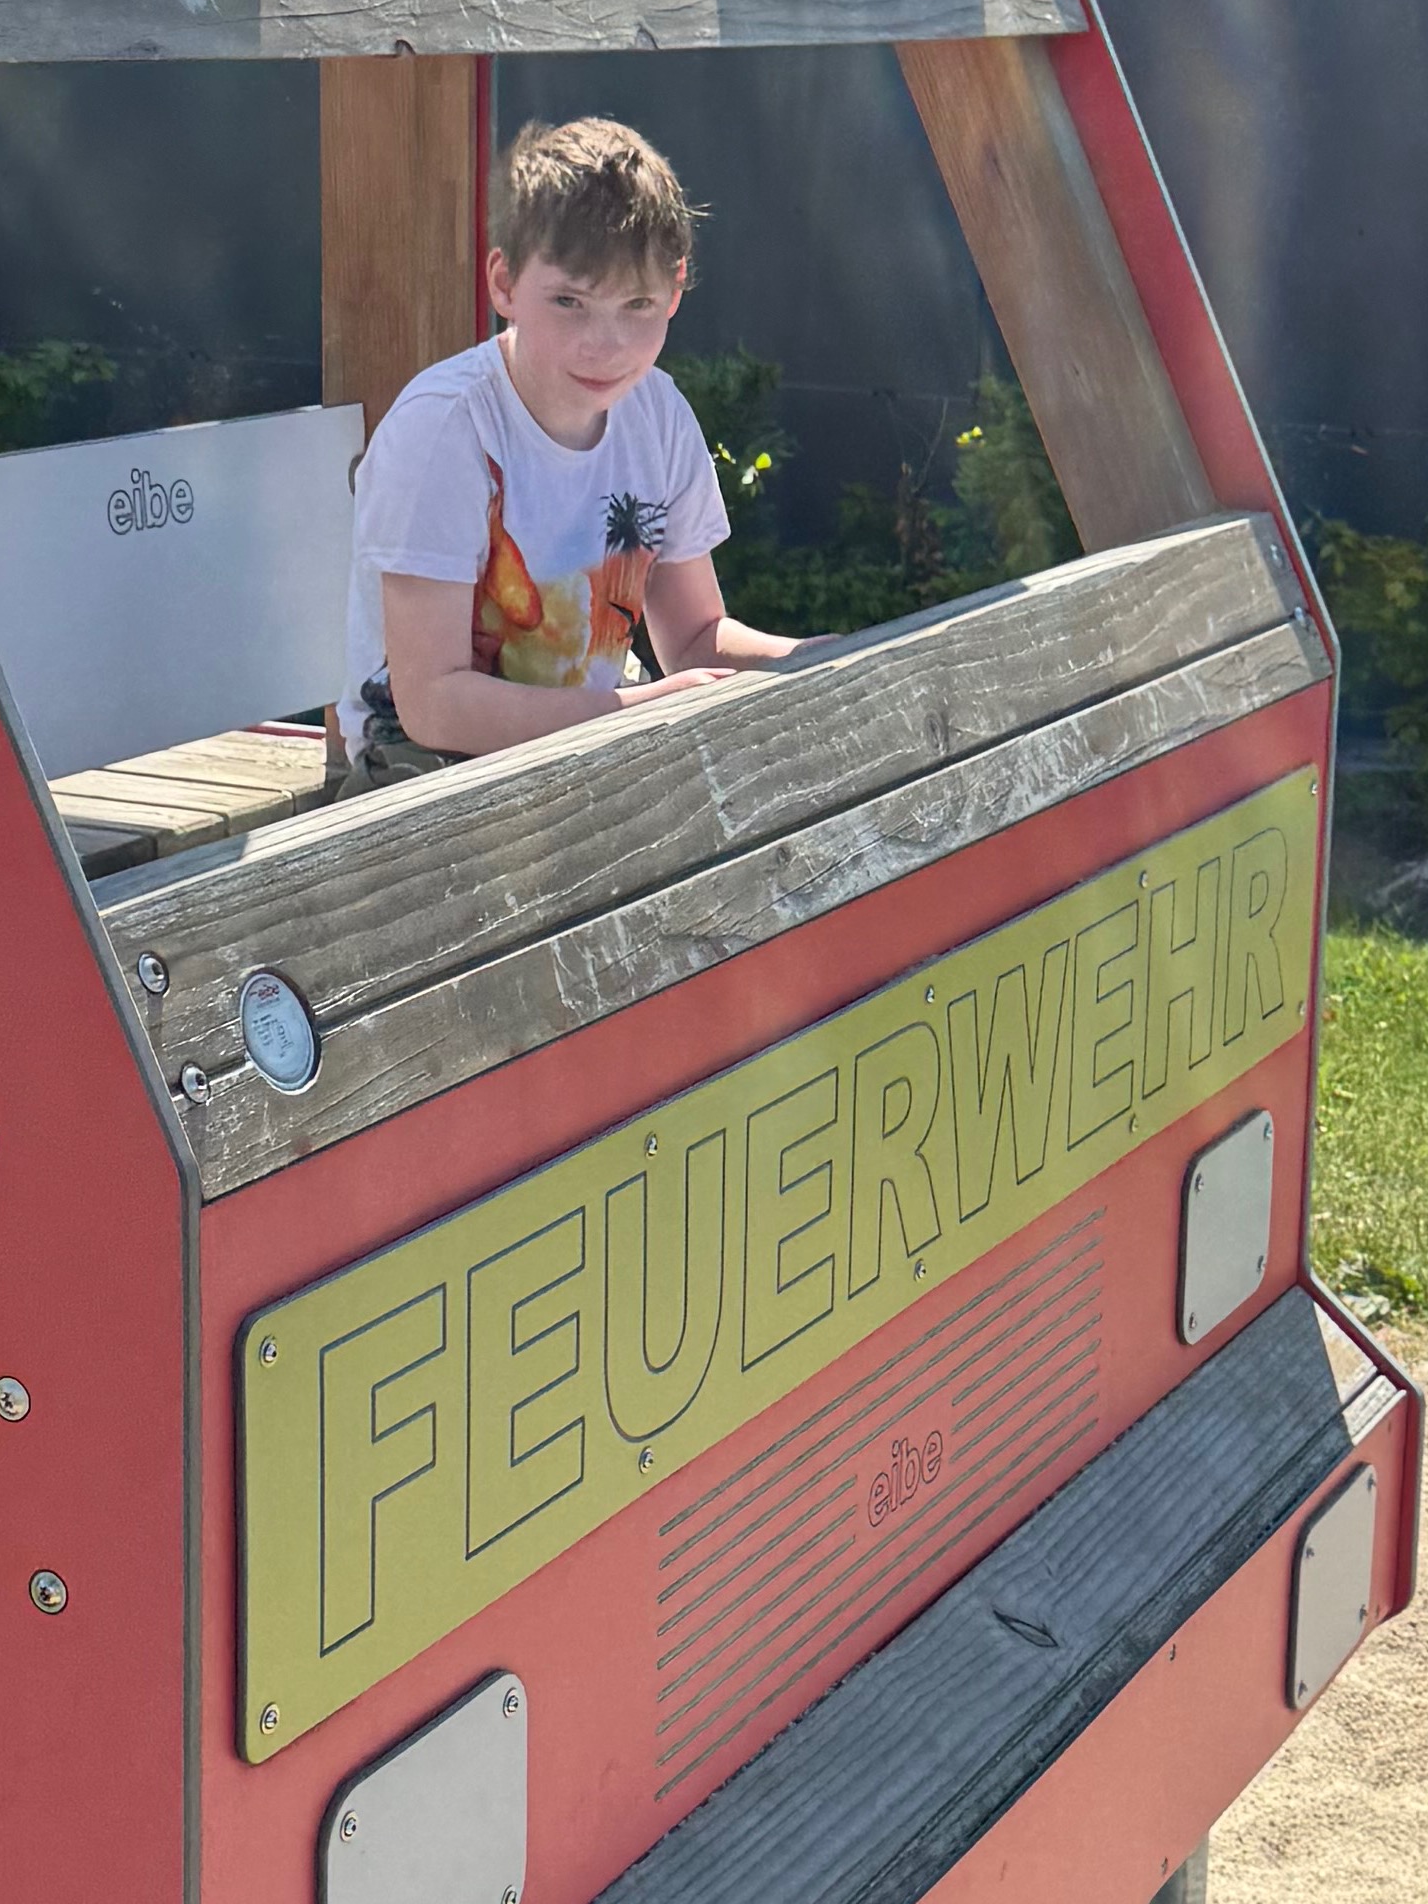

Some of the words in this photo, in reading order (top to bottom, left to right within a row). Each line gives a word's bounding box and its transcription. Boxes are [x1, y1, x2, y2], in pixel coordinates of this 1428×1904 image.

[107, 468, 194, 535] eibe
[320, 827, 1288, 1658] FEUERWEHR
[868, 1430, 943, 1527] eibe
